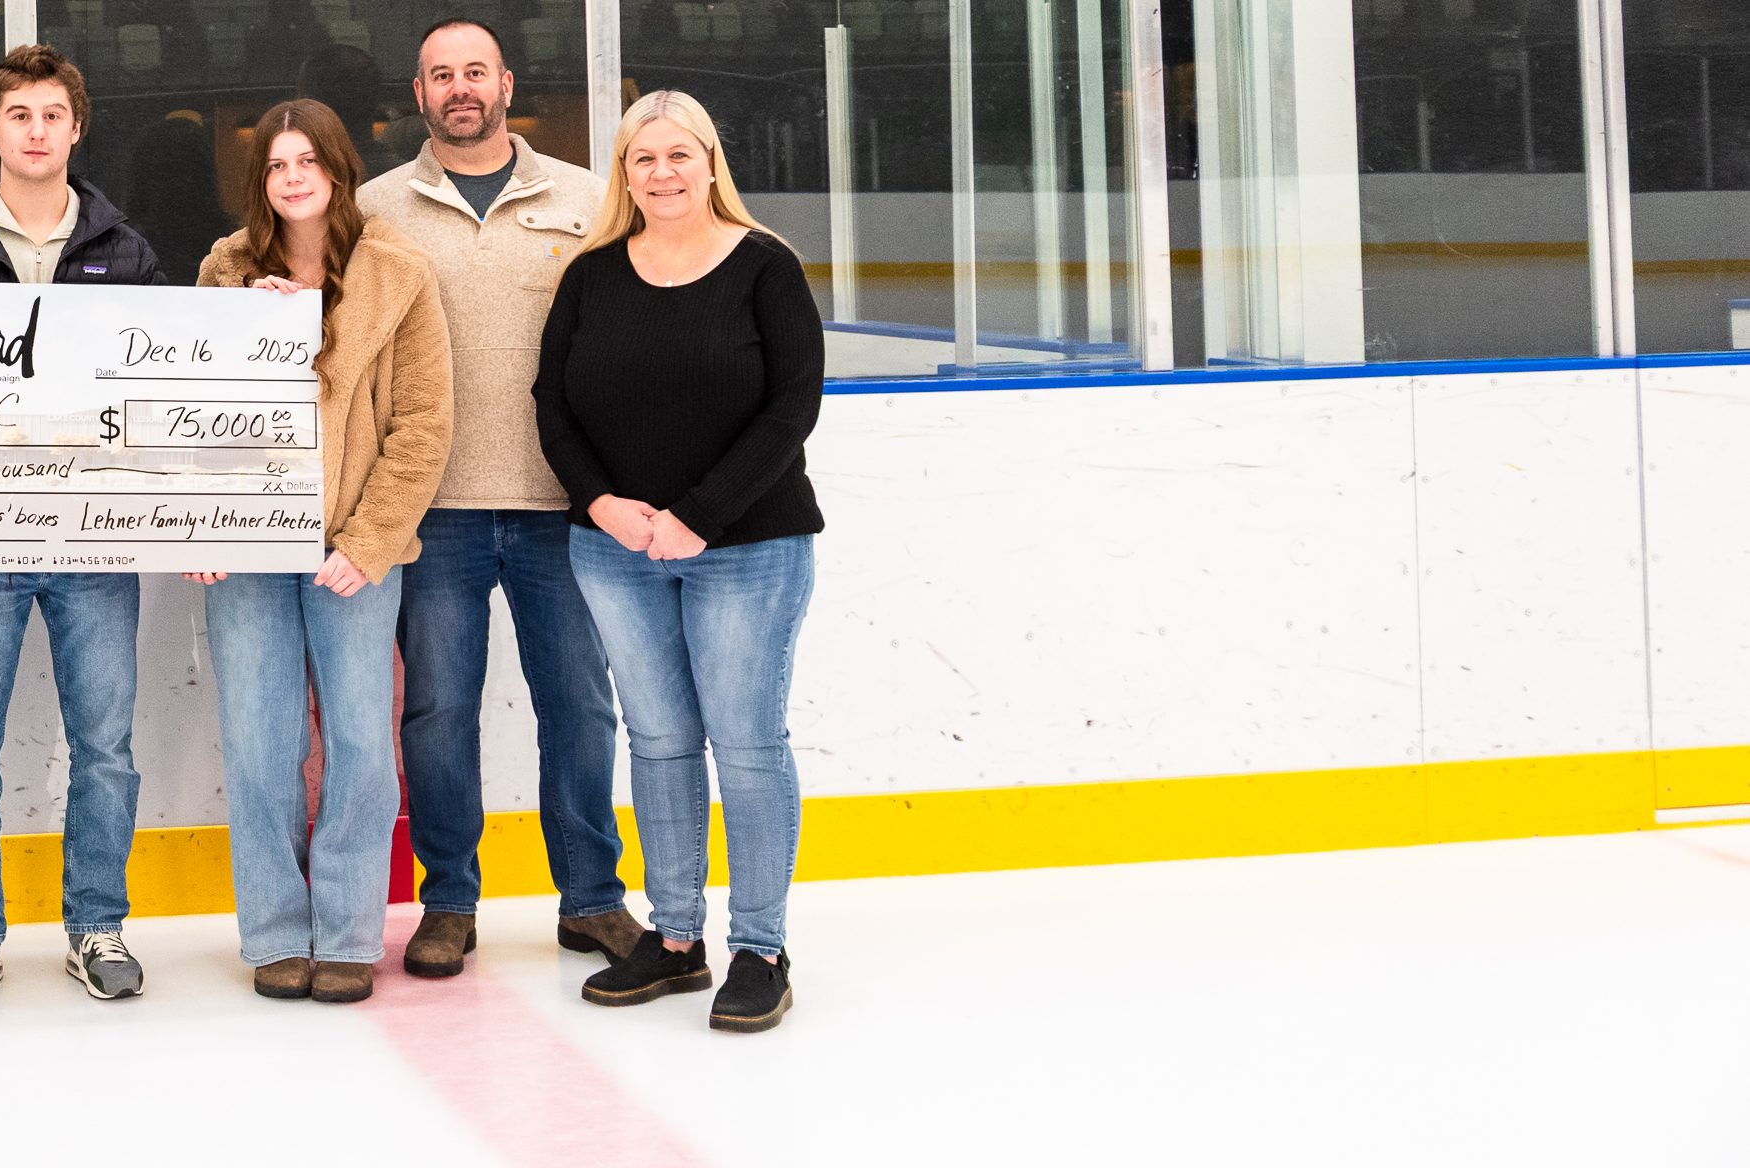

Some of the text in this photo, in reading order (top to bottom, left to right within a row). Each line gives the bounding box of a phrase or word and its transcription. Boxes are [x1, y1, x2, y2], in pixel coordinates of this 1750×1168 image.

[118, 327, 310, 367] Dec 16 2025
[95, 368, 118, 377] Date
[99, 406, 121, 445] $
[286, 481, 318, 491] Dollars
[14, 506, 59, 527] boxes
[80, 501, 147, 532] Lehner
[150, 504, 198, 540] Family
[211, 505, 265, 530] Lehner
